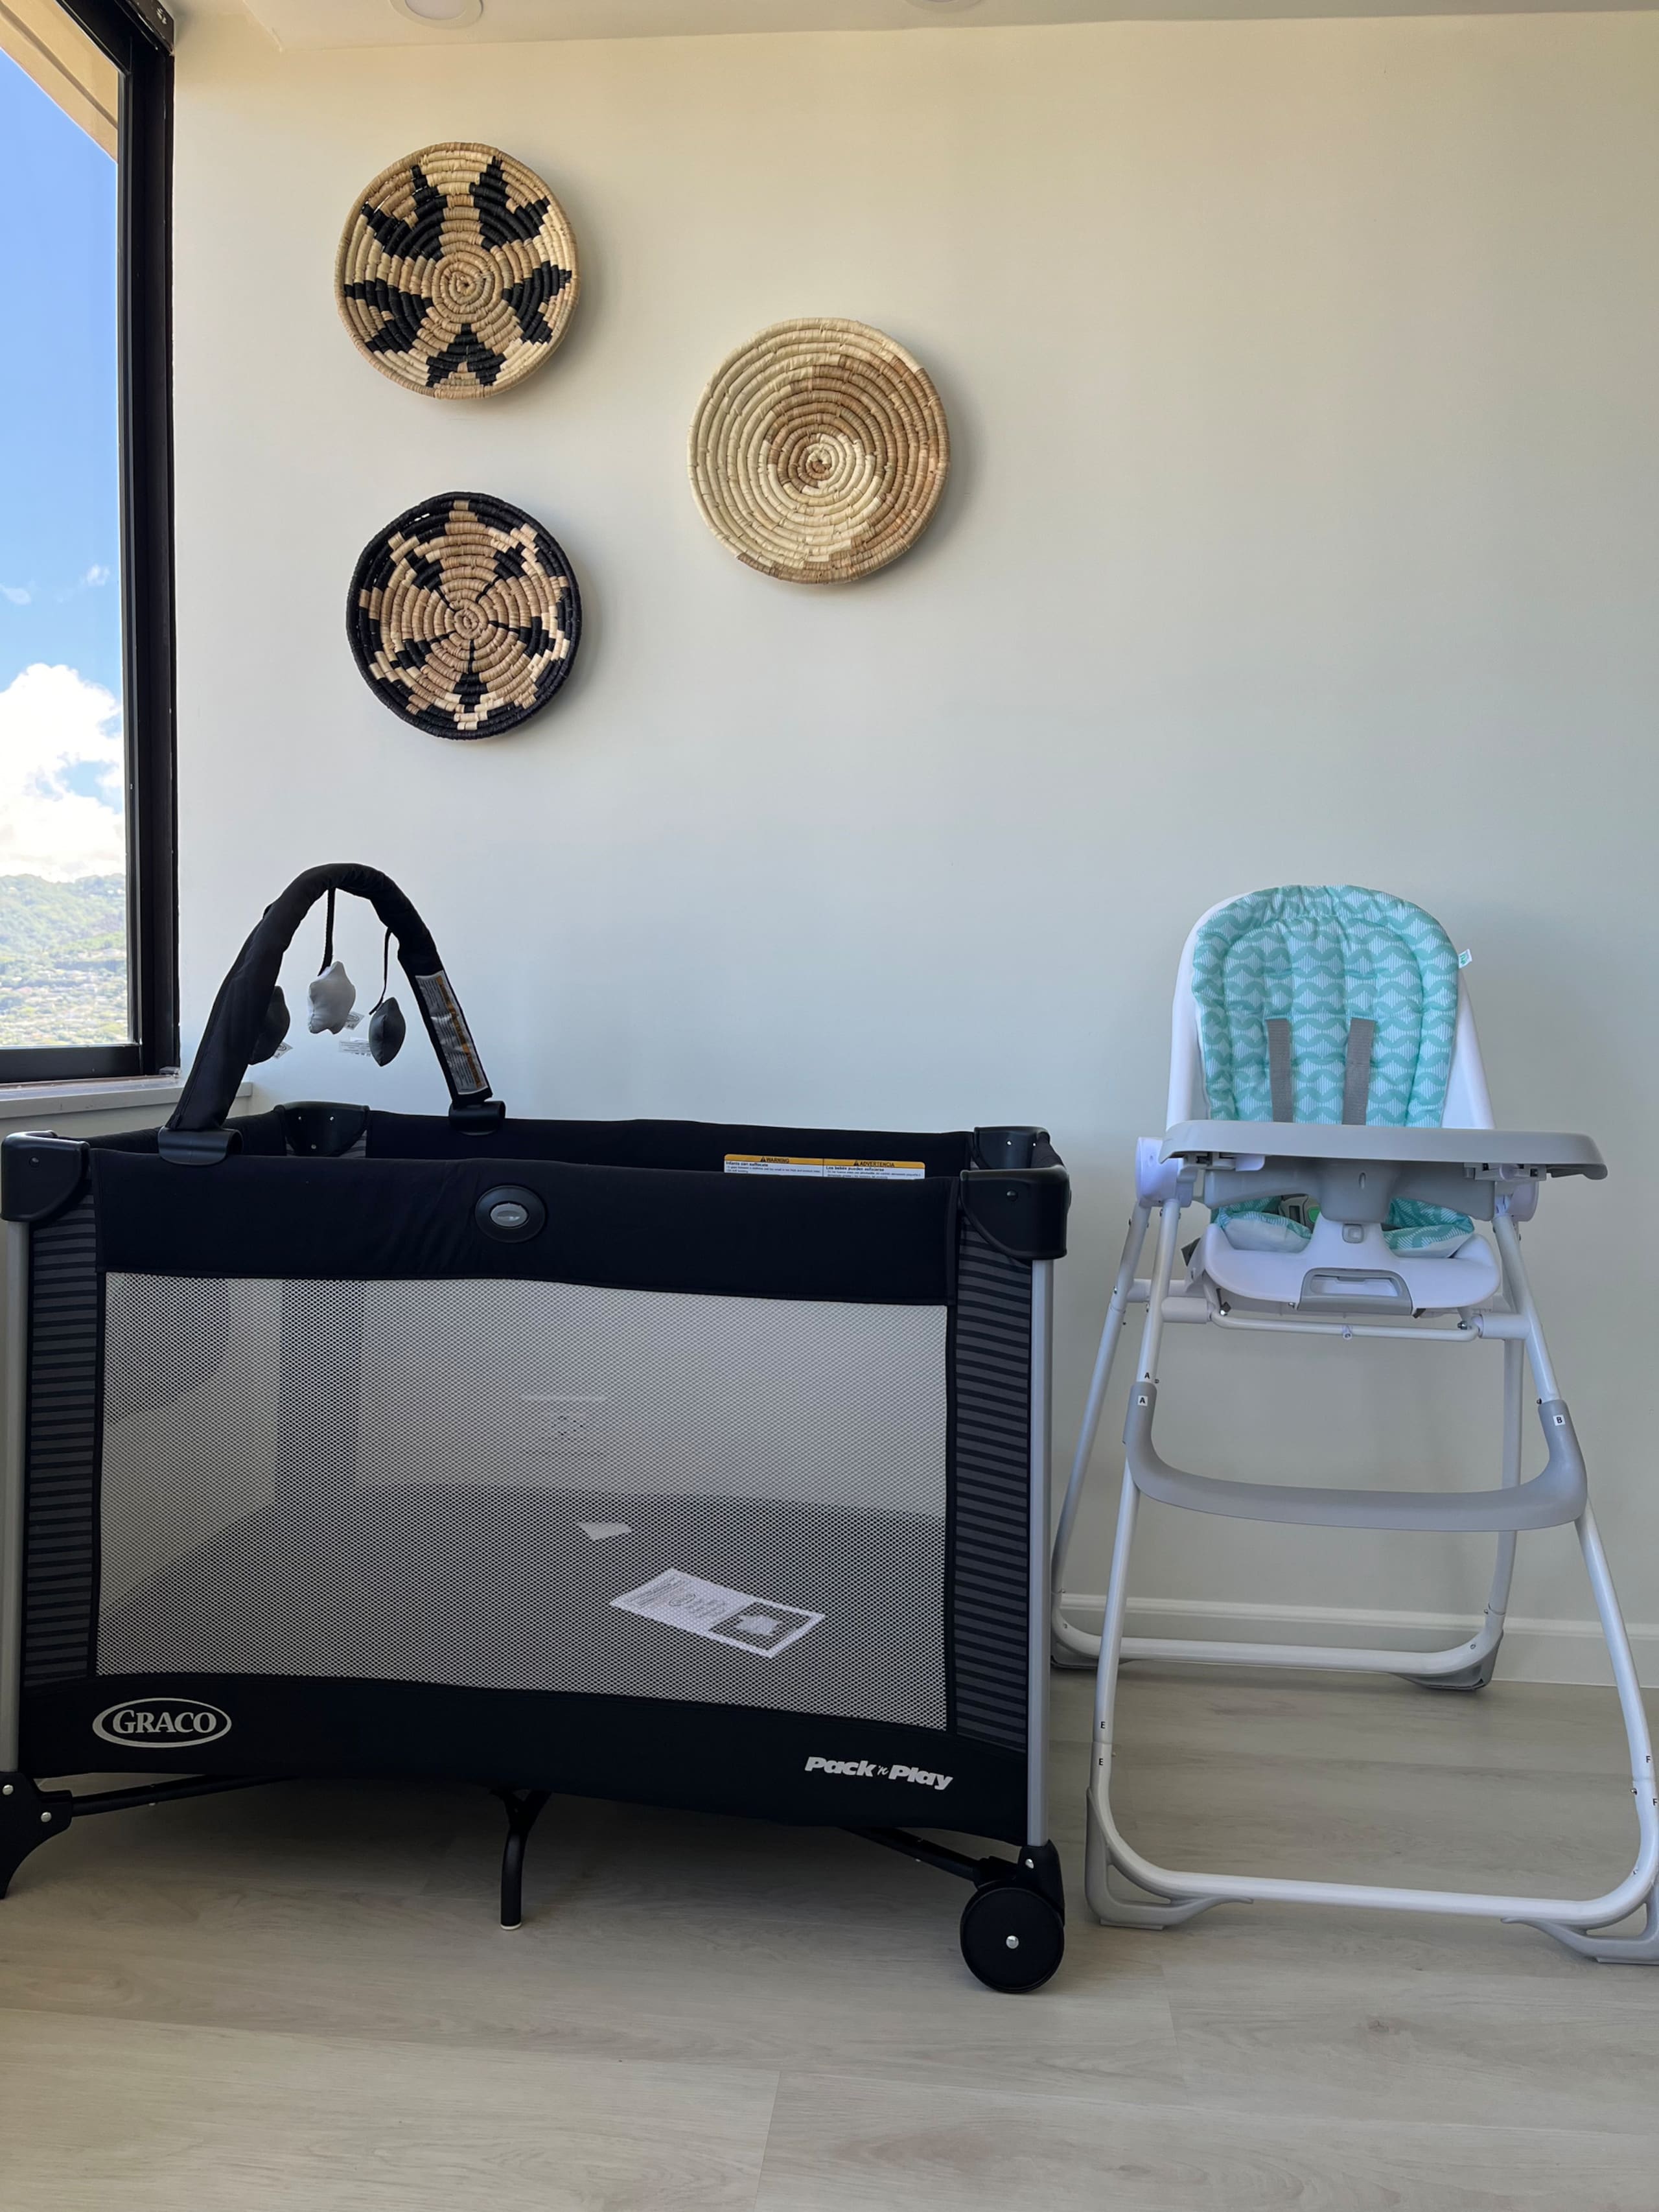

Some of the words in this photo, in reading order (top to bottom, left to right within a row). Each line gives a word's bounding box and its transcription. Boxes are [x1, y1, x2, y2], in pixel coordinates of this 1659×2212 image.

[113, 1710, 216, 1734] GRACO
[1100, 1721, 1106, 1729] E
[804, 1756, 877, 1777] Pack
[888, 1764, 953, 1791] Play
